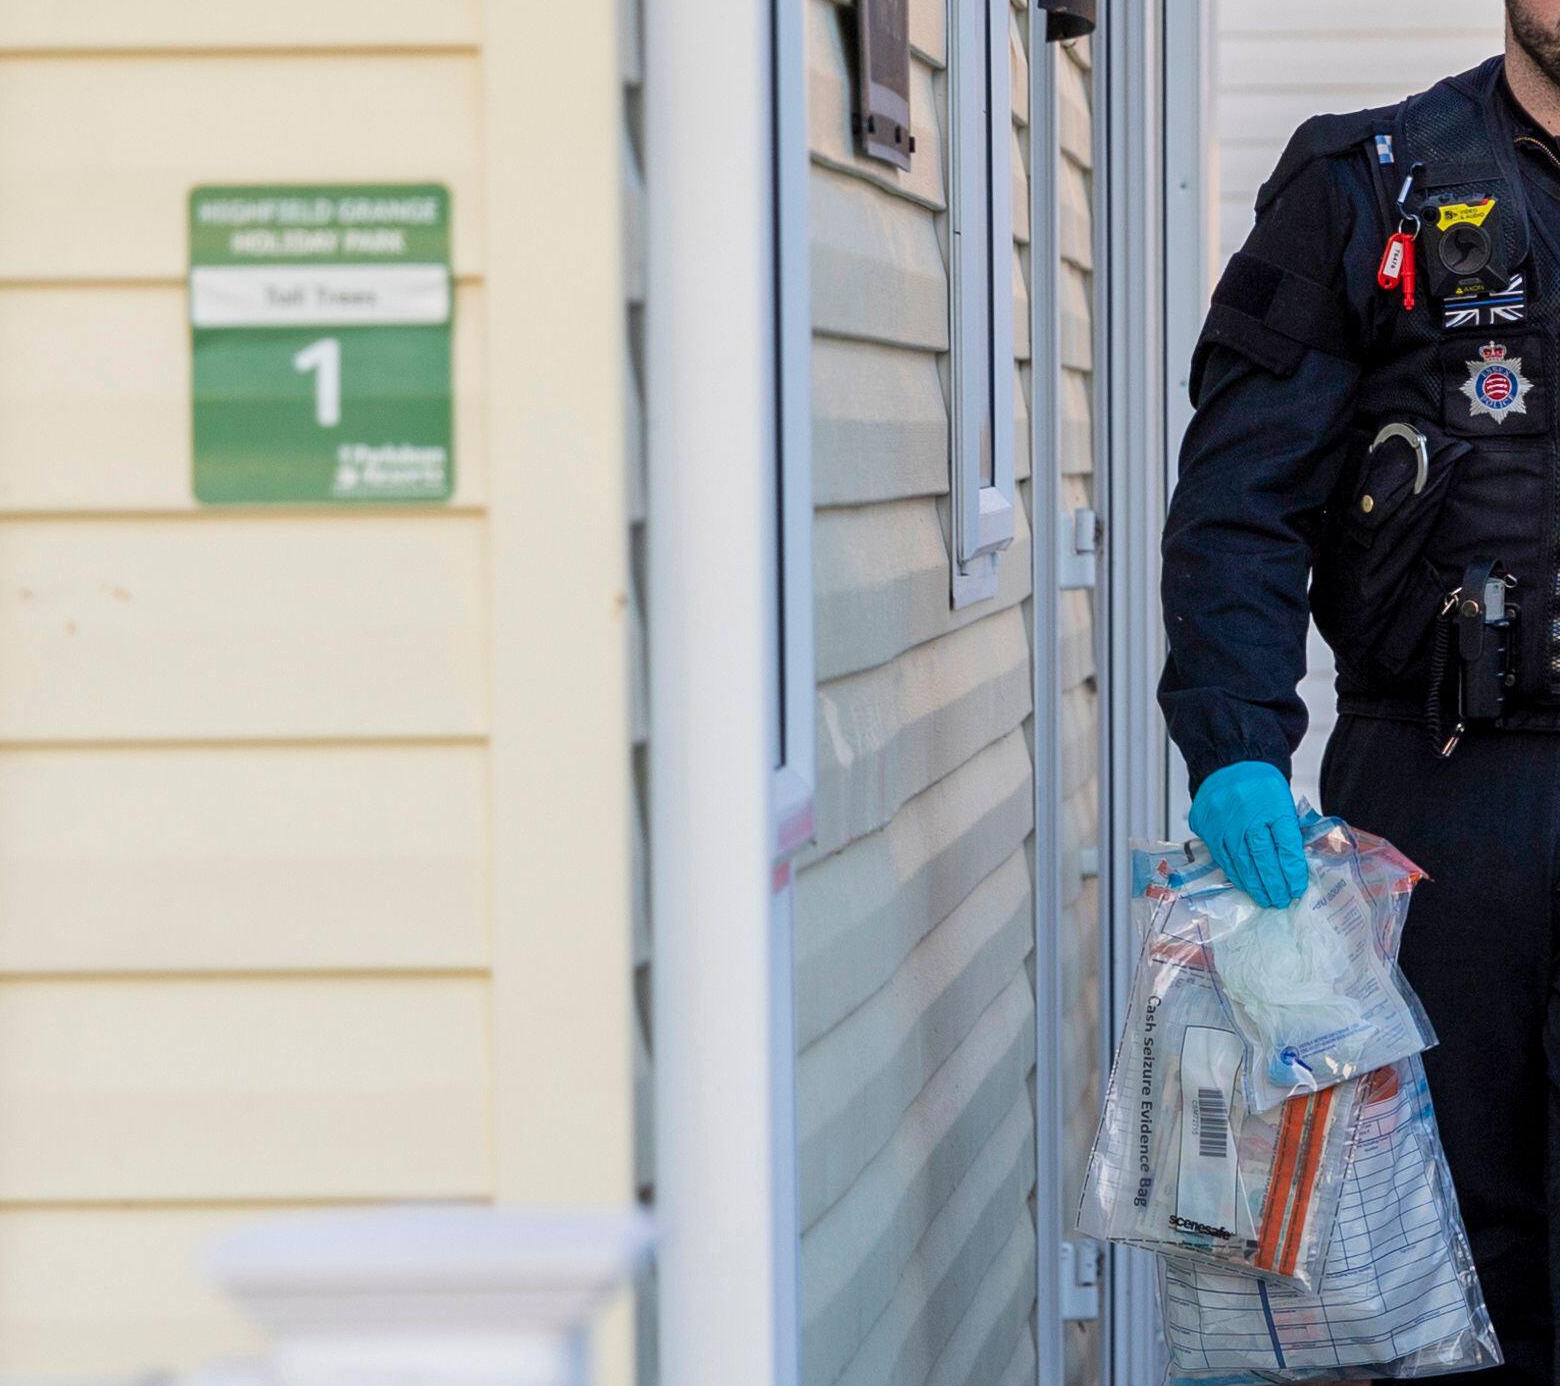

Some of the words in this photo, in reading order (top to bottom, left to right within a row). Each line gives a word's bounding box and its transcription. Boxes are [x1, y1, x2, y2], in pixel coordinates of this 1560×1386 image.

[294, 337, 340, 426] 1
[1480, 393, 1515, 409] POLICE
[1145, 995, 1162, 1032] Cash
[1141, 1037, 1155, 1096] Seizure
[1140, 1100, 1153, 1173] Evidence
[1133, 1177, 1152, 1207] Bag
[1168, 1214, 1231, 1241] scenesafe
